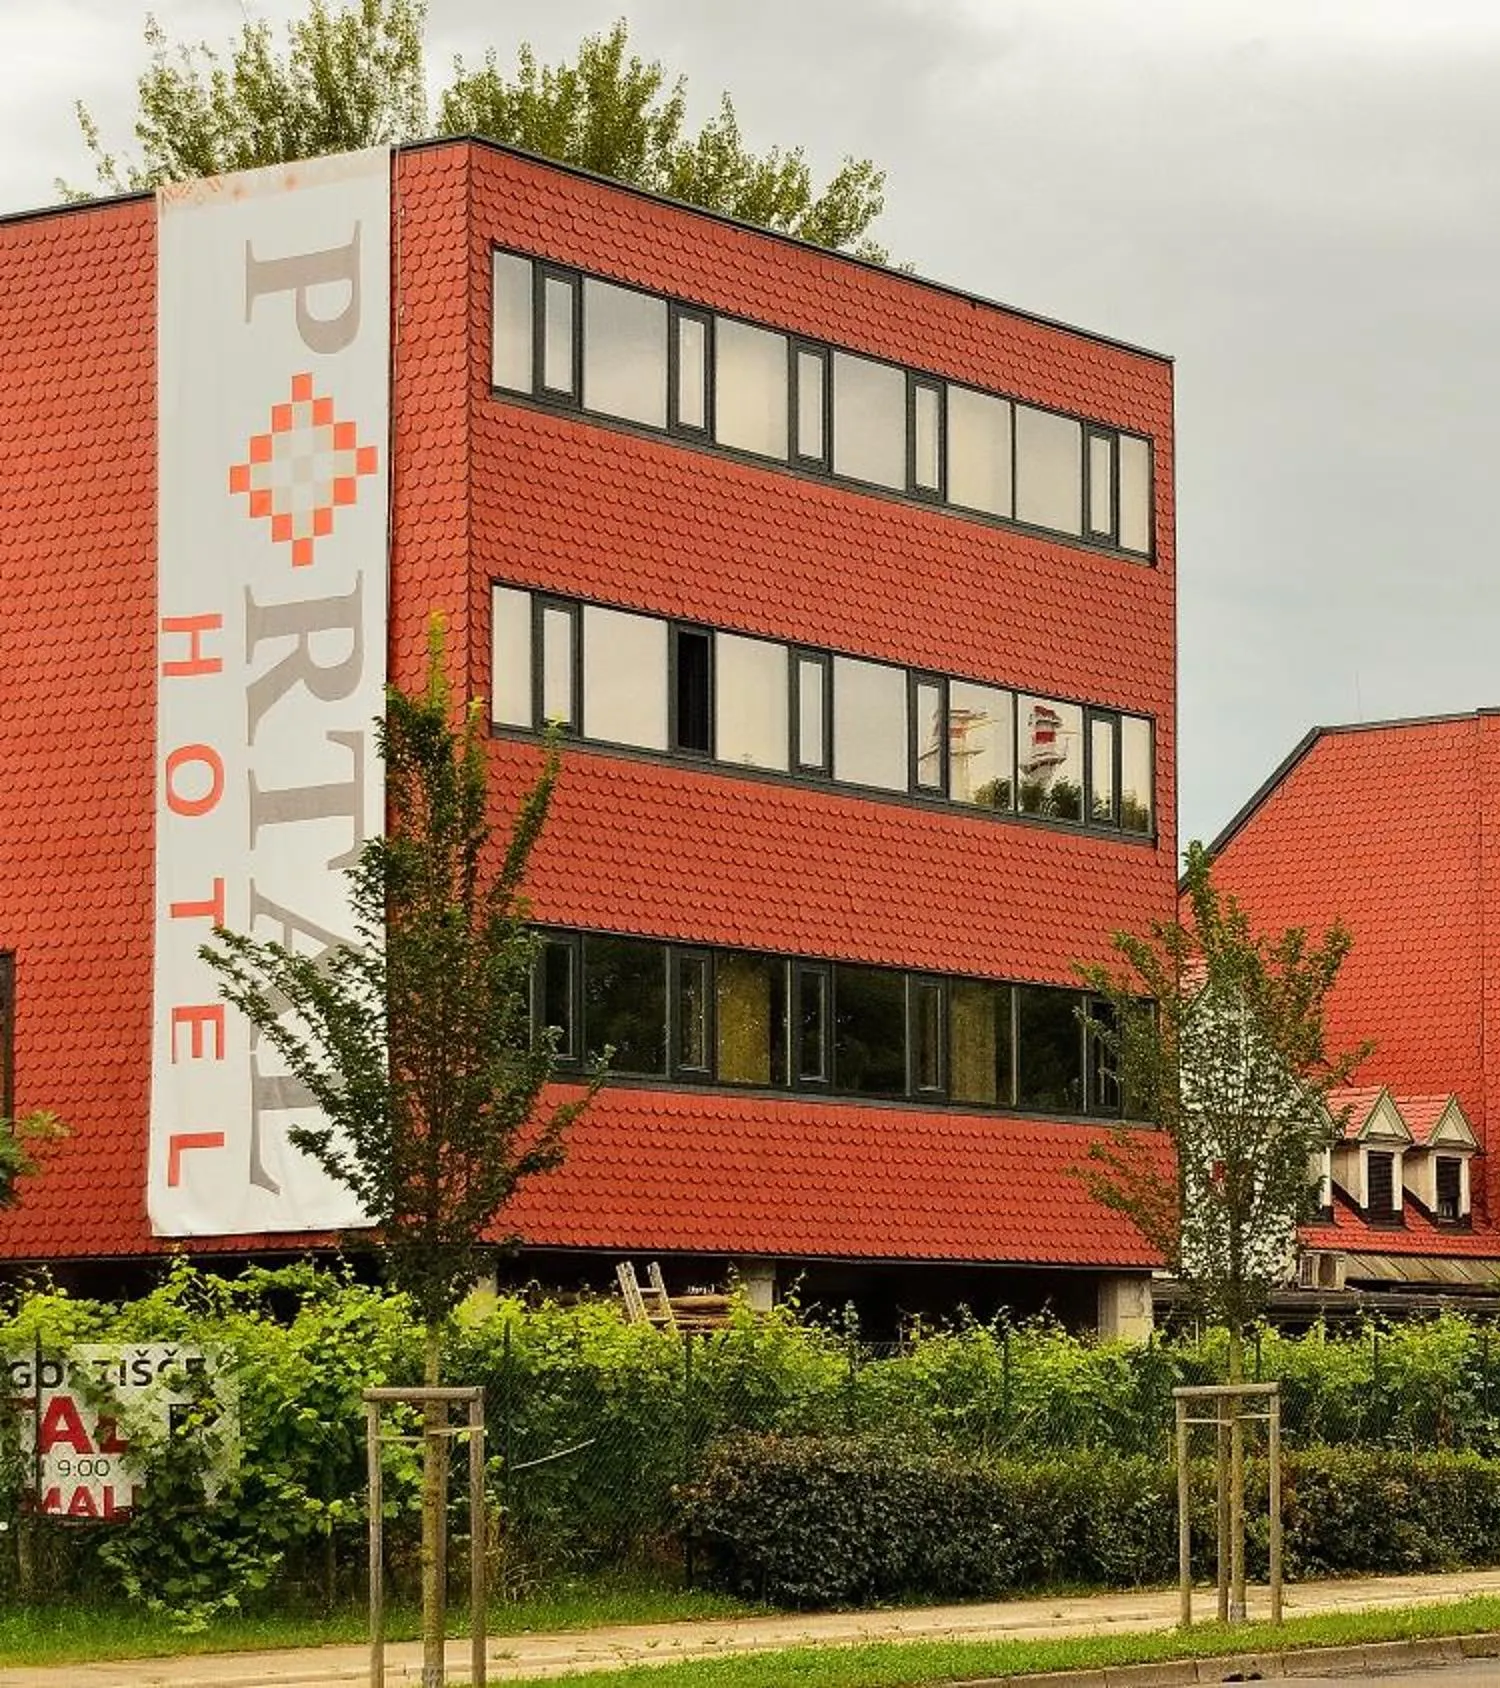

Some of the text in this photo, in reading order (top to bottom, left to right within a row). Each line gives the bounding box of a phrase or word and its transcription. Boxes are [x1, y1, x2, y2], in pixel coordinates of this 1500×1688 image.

[162, 612, 225, 1188] HOTEL
[8, 1349, 206, 1389] GOTIŠČE
[57, 1459, 111, 1477] 9:00
